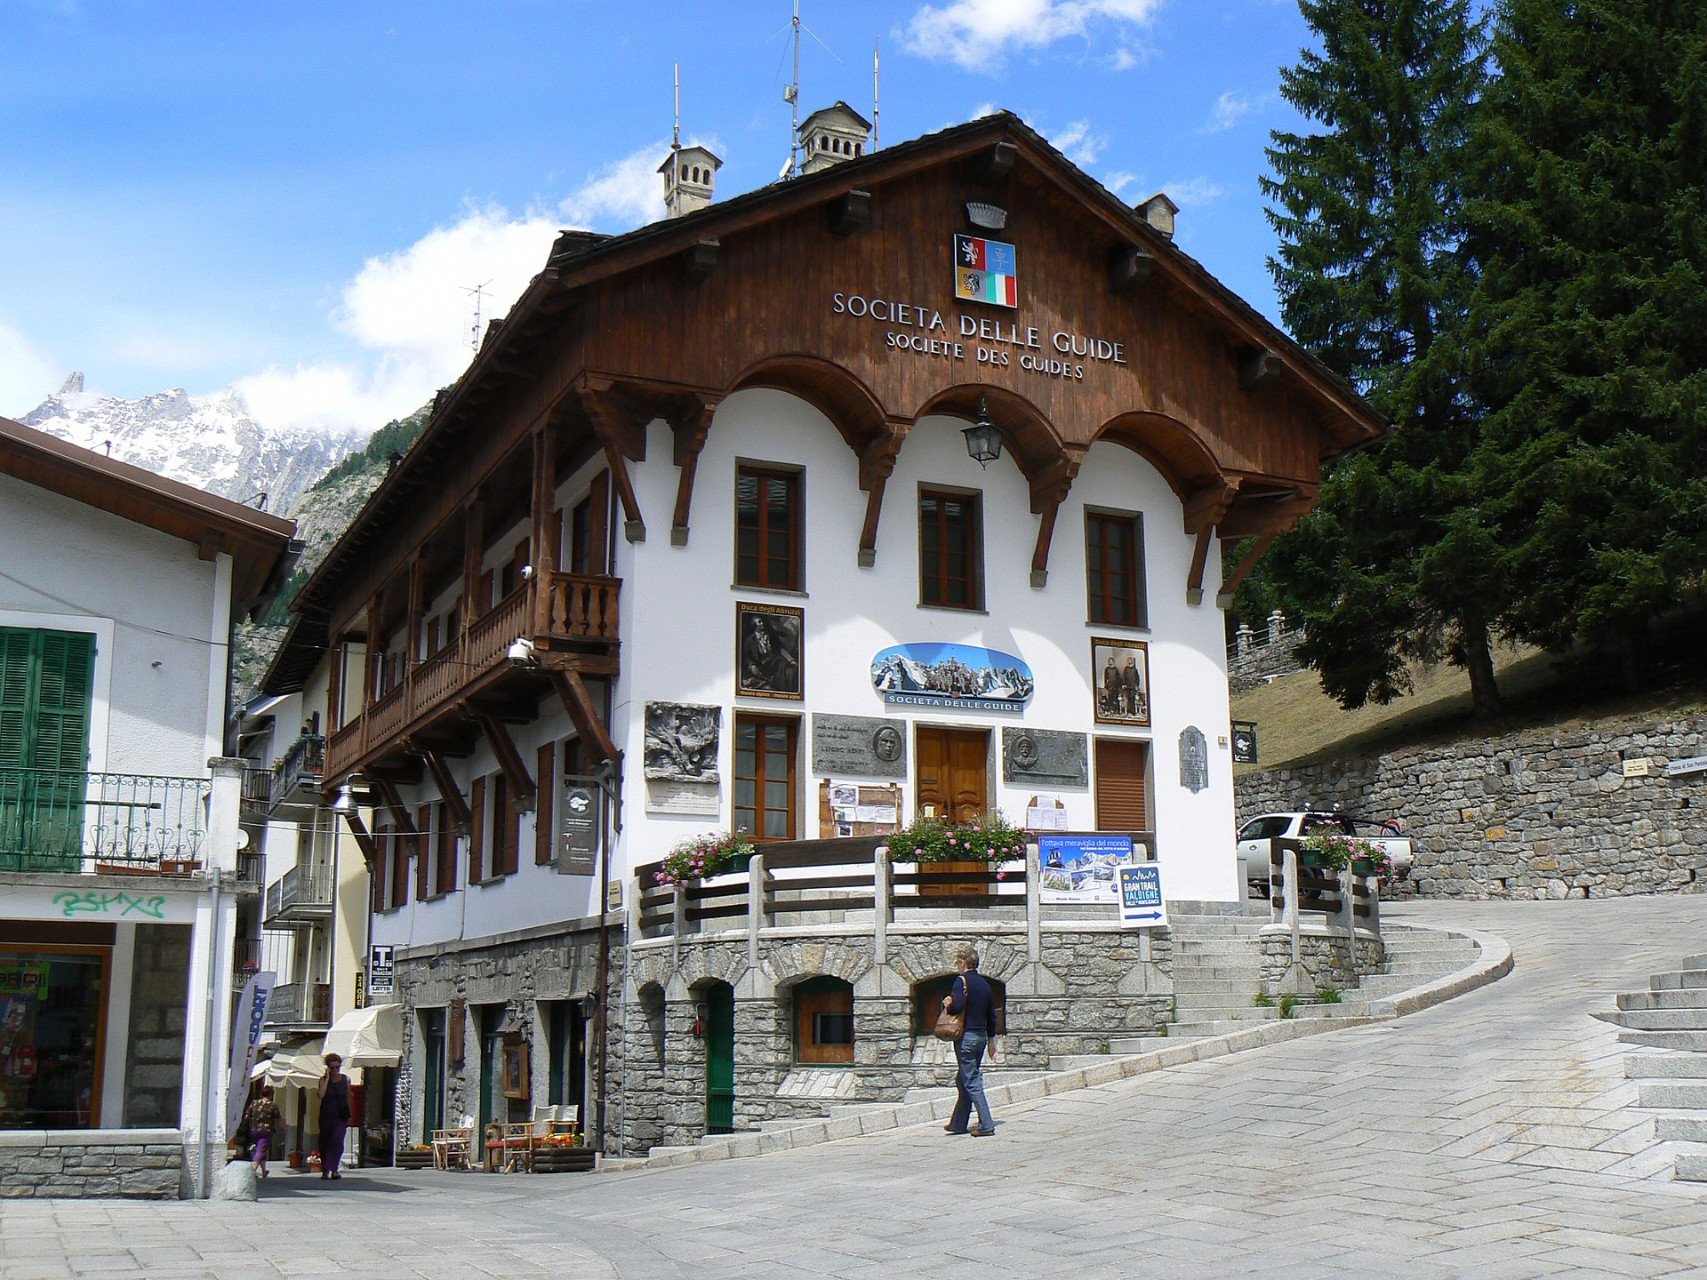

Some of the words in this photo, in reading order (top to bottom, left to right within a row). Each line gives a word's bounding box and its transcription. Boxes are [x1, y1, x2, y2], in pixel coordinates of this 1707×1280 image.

[833, 293, 946, 332] SOCIETA
[960, 314, 1041, 348] DELLE
[1053, 332, 1127, 363] GUIDE
[886, 331, 964, 359] SOCIETE
[977, 346, 1008, 366] DES
[1020, 354, 1084, 379] GUIDES
[759, 605, 775, 613] degli
[776, 607, 800, 615] Abruzzi
[944, 700, 981, 709] DELLE
[984, 702, 1020, 711] GUIDE
[1064, 839, 1095, 848] meraviglia
[1096, 839, 1106, 847] del
[1107, 839, 1129, 847] mondo
[1124, 882, 1140, 891] GRAN
[1140, 881, 1158, 890] TRAIL
[1125, 890, 1159, 901] VALDIGNE
[375, 947, 391, 967] T
[357, 975, 363, 988] 24
